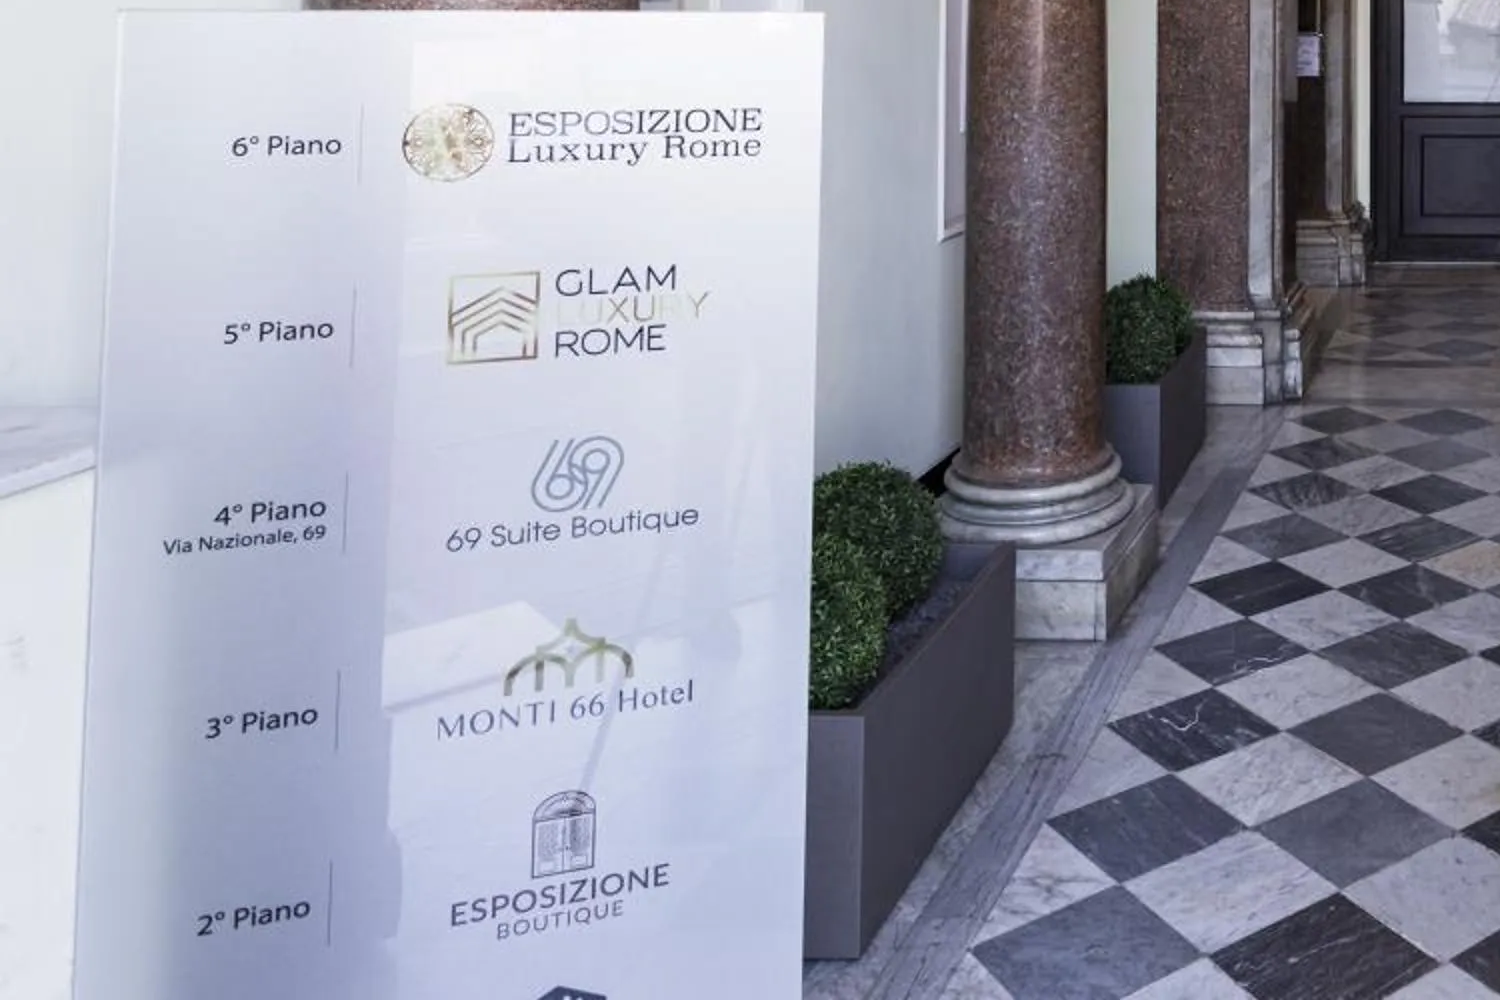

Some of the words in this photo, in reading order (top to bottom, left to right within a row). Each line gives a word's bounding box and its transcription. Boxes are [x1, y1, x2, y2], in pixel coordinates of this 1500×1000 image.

[508, 108, 762, 137] ESPOSIZIONE
[267, 135, 342, 157] Piano
[507, 138, 648, 167] Luxury
[661, 134, 762, 159] Rome
[555, 263, 677, 297] GLAM
[258, 320, 335, 343] Piano
[554, 323, 667, 359] ROME
[250, 500, 327, 524] Piano
[162, 538, 193, 556] Via
[198, 528, 299, 553] Nazionale,
[302, 524, 327, 541] 69
[446, 527, 482, 553] 69
[490, 520, 561, 548] Suite
[570, 508, 700, 539] Boutique
[241, 708, 319, 734] Piano
[437, 699, 556, 741] MONTI
[569, 693, 605, 721] 66
[618, 678, 694, 713] Hotel
[450, 862, 671, 928] ESPOSIZIONE
[233, 901, 311, 931] Piano
[496, 900, 624, 942] BOUTIQUE
